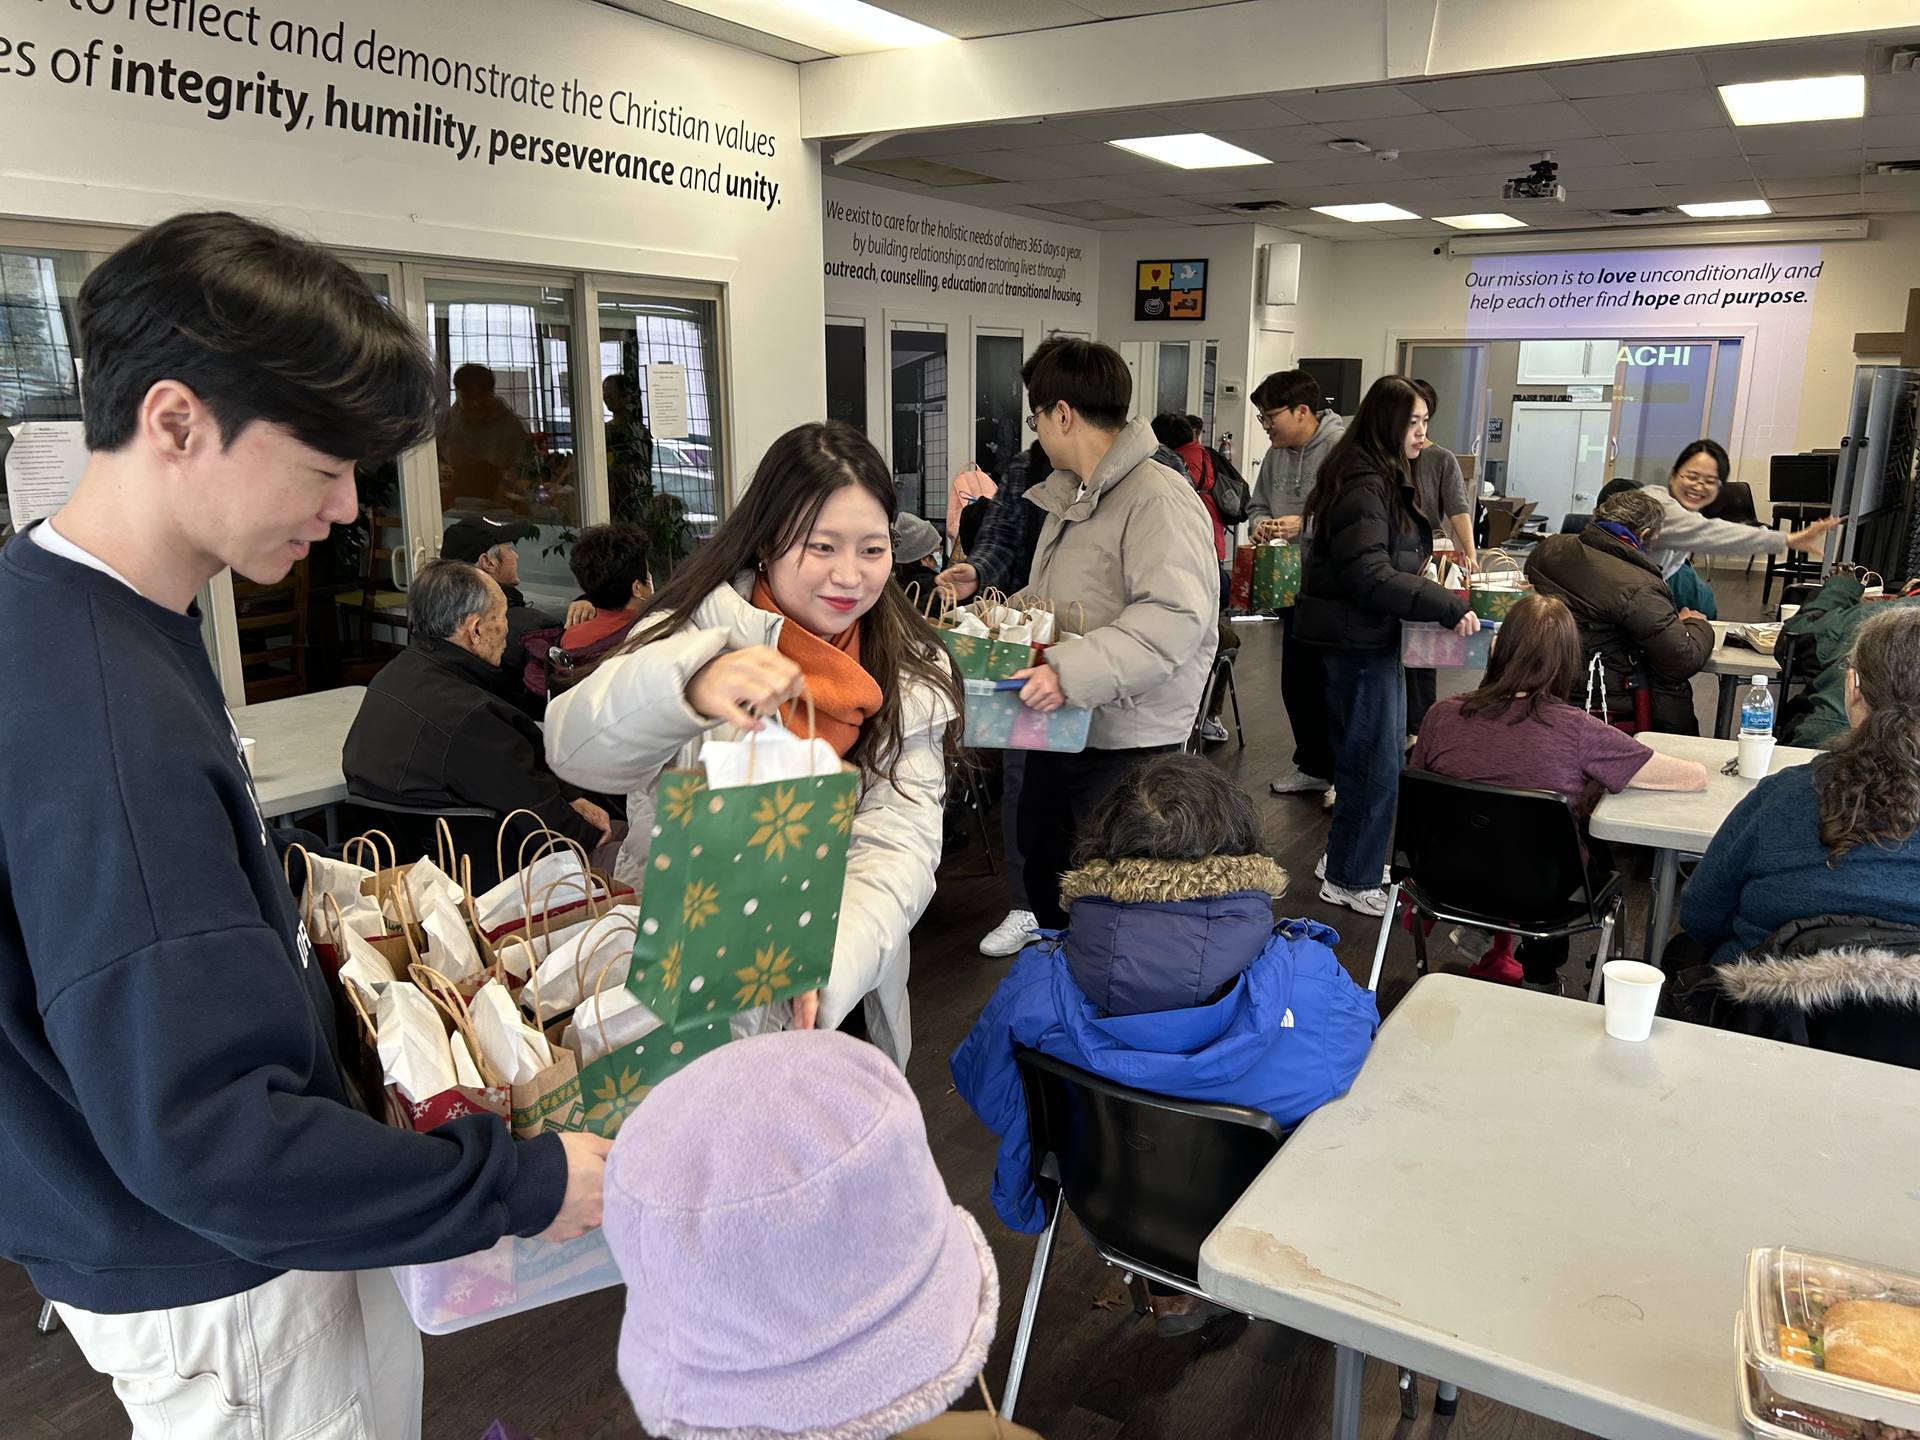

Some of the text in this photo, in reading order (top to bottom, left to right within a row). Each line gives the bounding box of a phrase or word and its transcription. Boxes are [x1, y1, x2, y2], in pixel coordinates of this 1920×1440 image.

[129, 0, 776, 157] reflect and demonstrate the Christian values
[51, 39, 104, 87] of
[111, 44, 315, 132] integrity,
[324, 84, 481, 160] humility,
[489, 128, 675, 186] perseverance
[679, 163, 721, 194] and
[725, 171, 781, 212] unity.
[826, 200, 844, 221] We
[845, 206, 870, 225] exist
[872, 210, 882, 227] to
[884, 214, 905, 231] care
[906, 214, 920, 233] for
[921, 217, 937, 237] the
[937, 220, 969, 242] holistic
[969, 228, 994, 246] needs
[994, 231, 1004, 247] of
[1003, 234, 1028, 251] others
[1028, 237, 1043, 253] 365
[1043, 240, 1060, 259] days
[1060, 245, 1066, 257] a
[853, 232, 1066, 282] by building relationships and restoring lives through
[1465, 260, 1825, 287] Our mission is to love unconditionally and
[823, 260, 1082, 306] outreach, counselling, education and transitional housing.
[1470, 288, 1808, 313] help each other find hope and purpose.
[1615, 346, 1691, 366] ACHI
[1512, 394, 1538, 402] PRAISE
